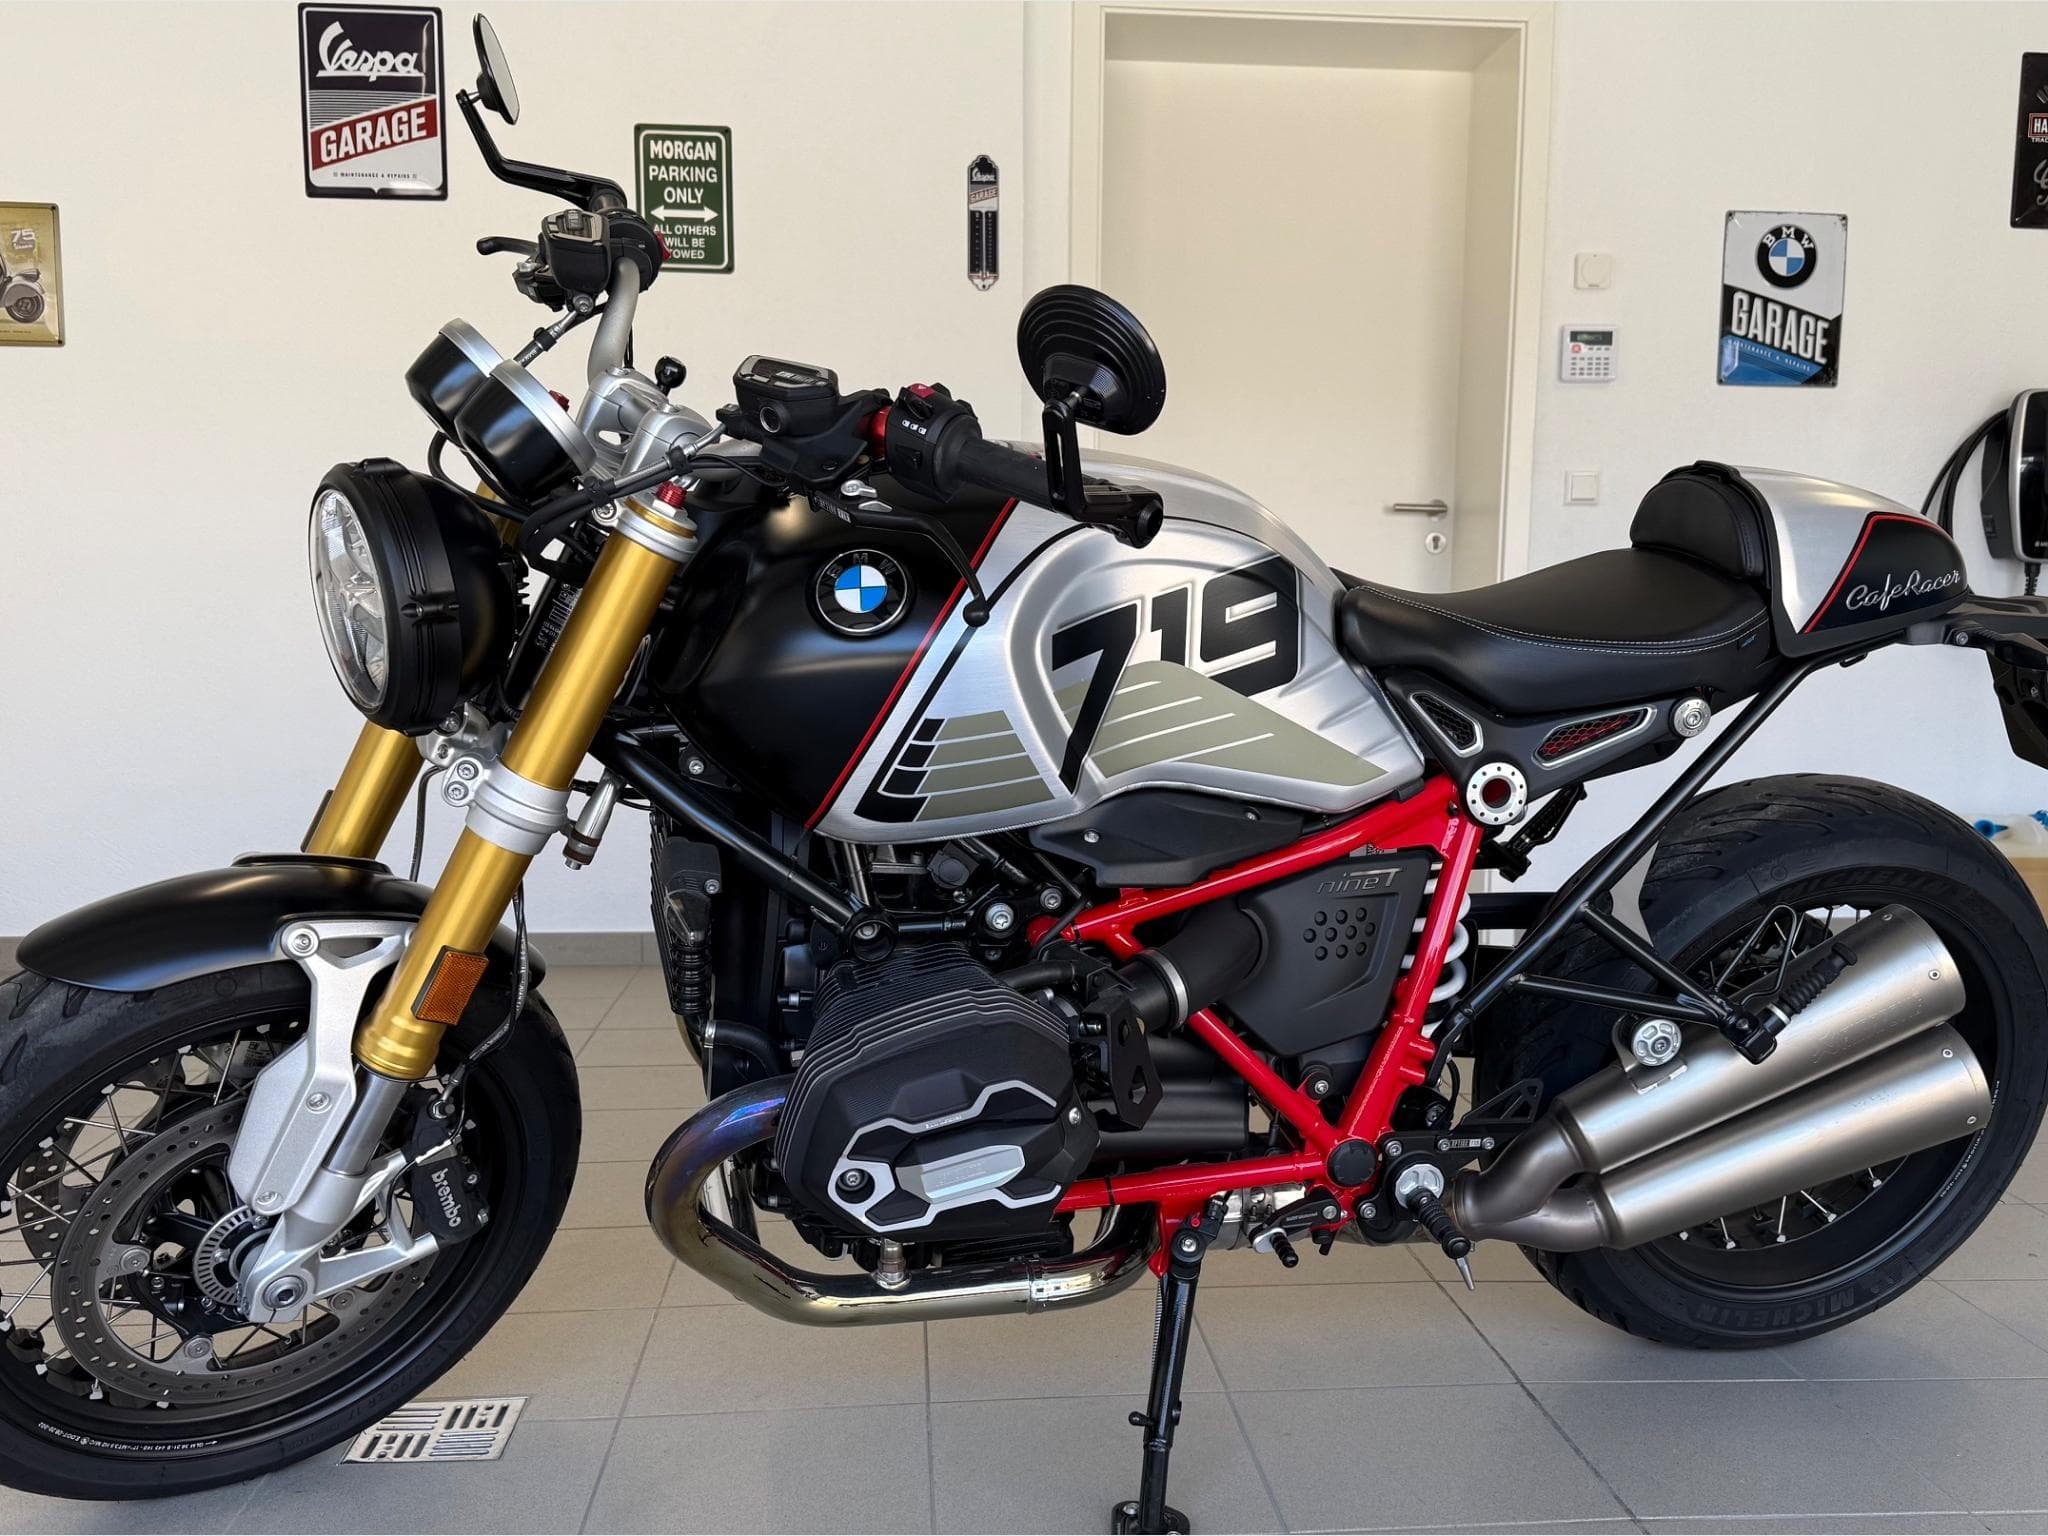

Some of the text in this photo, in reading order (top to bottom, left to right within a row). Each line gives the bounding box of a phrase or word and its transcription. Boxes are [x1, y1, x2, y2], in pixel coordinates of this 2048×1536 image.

[317, 21, 424, 82] Vespa
[320, 106, 427, 164] GARAGE
[650, 140, 717, 161] MORGAN
[649, 165, 718, 183] PARKING
[663, 186, 704, 204] ONLY
[11, 229, 36, 243] 75
[653, 224, 717, 236] ALL OTHERS
[1762, 226, 1814, 249] BMW
[665, 237, 706, 248] WILL BE
[1731, 291, 1831, 364] GARAGE
[826, 552, 897, 579] BMW
[1317, 867, 1401, 894] nineT
[431, 1167, 462, 1228] brembo
